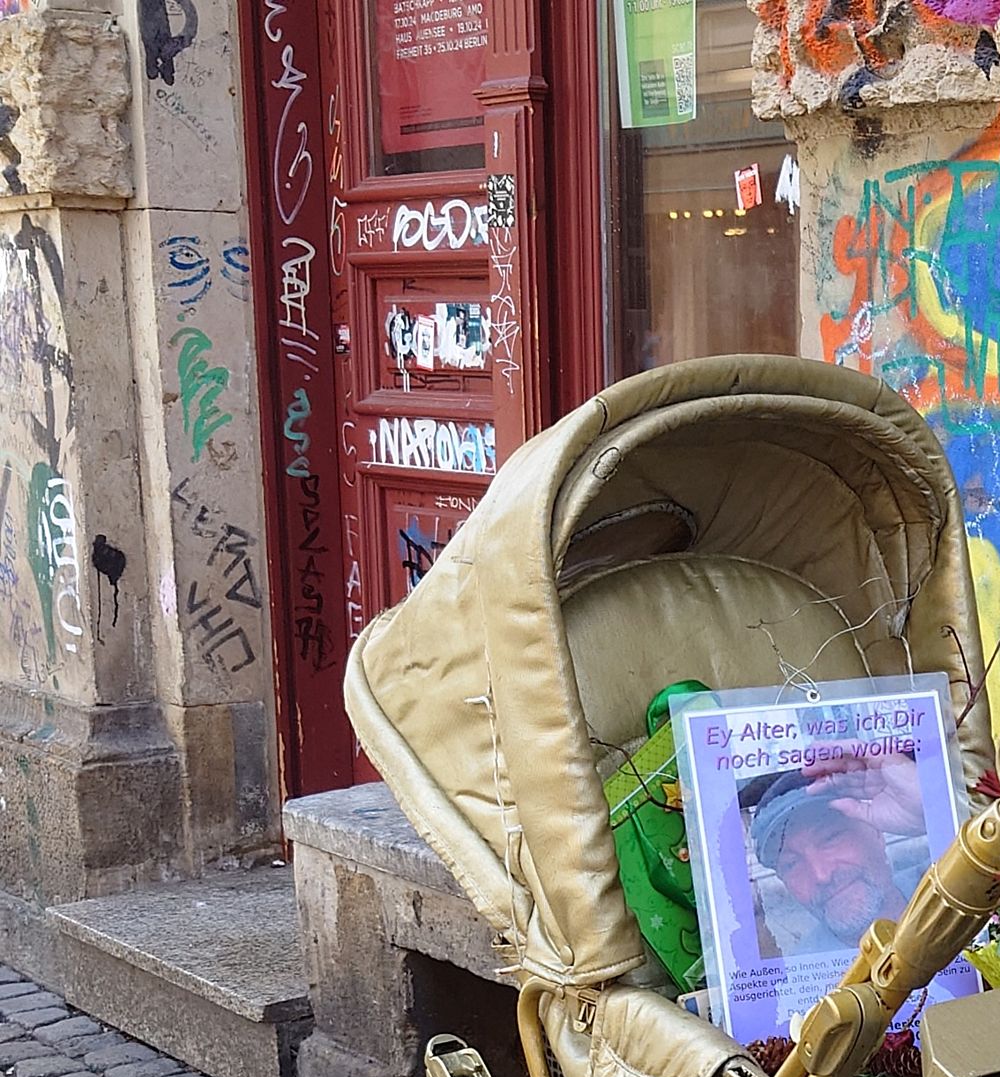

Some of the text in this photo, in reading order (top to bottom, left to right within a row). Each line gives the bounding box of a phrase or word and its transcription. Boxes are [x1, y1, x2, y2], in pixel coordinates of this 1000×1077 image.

[396, 31, 412, 43] HAUS
[396, 46, 423, 59] FREIHEIT
[464, 35, 488, 48] BERLIN
[707, 709, 926, 749] Ey Alter, was ich Dir
[716, 736, 922, 771] noch sagen wollte:
[729, 971, 747, 981] Wie
[750, 967, 784, 978] Außen,
[831, 958, 849, 967] Wie
[729, 979, 768, 992] Aspekte
[770, 976, 788, 986] und
[791, 973, 810, 983] alte
[960, 965, 971, 974] zu
